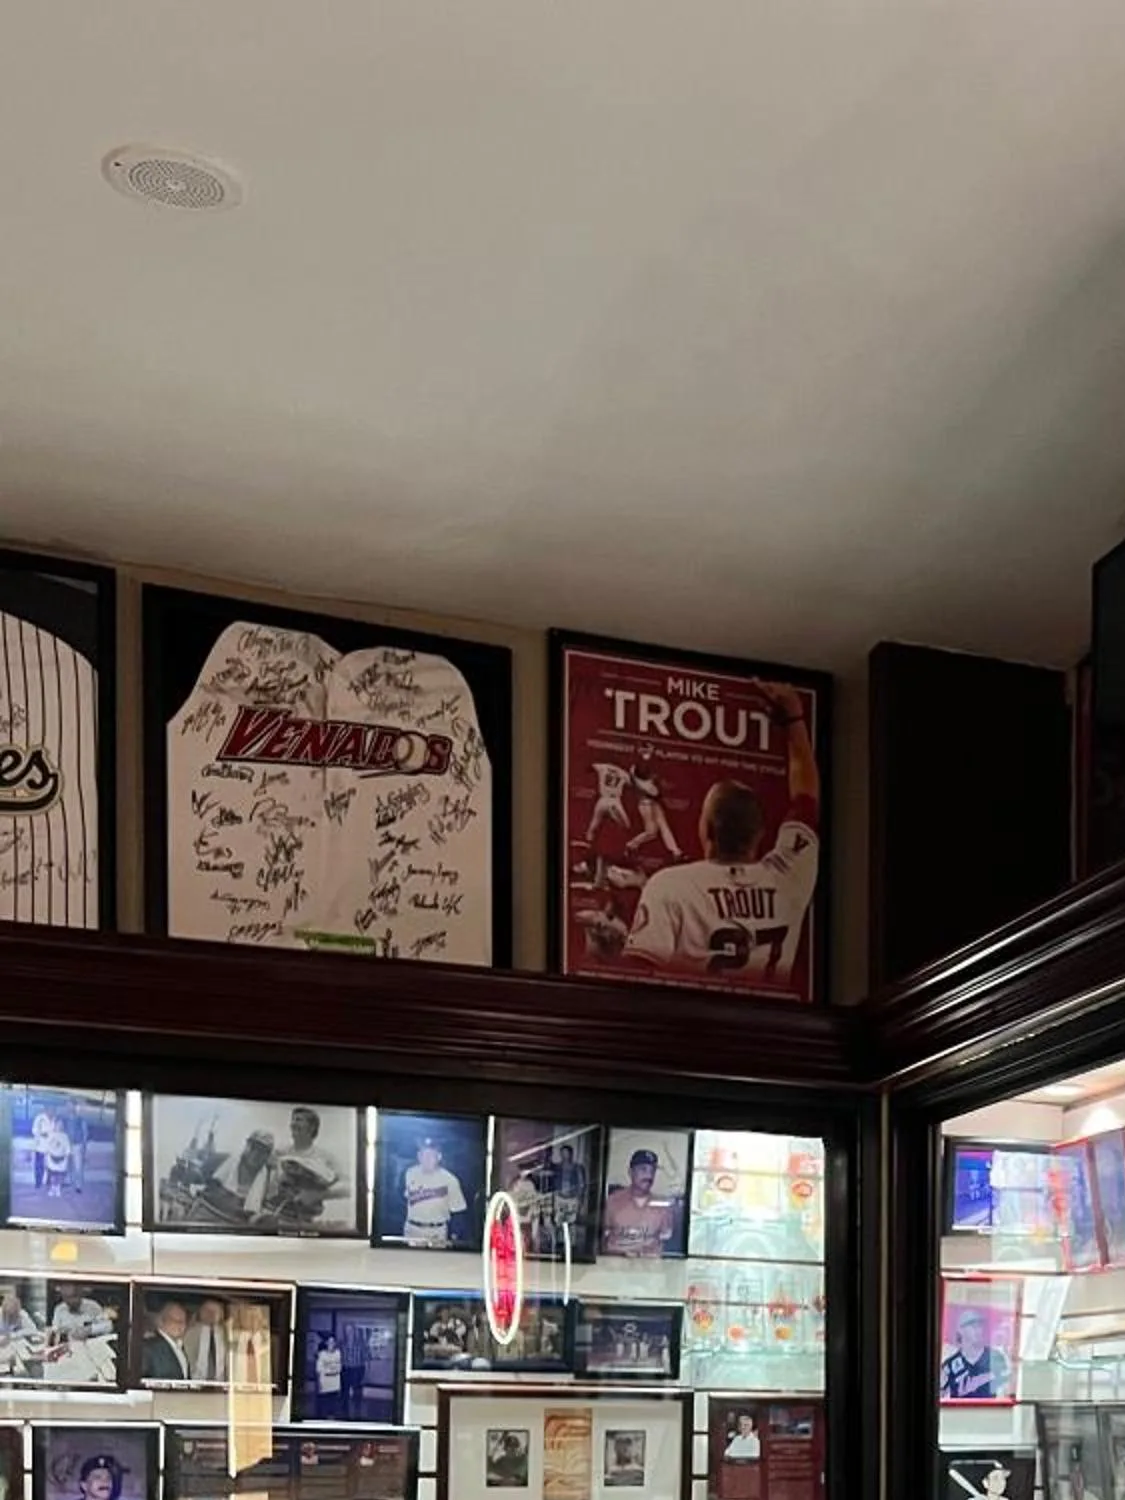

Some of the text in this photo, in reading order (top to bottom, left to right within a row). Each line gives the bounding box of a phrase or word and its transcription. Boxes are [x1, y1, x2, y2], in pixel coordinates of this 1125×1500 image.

[667, 676, 720, 701] MIKE
[604, 688, 770, 750] TROUT
[708, 888, 776, 920] TROUT
[706, 926, 789, 976] 27
